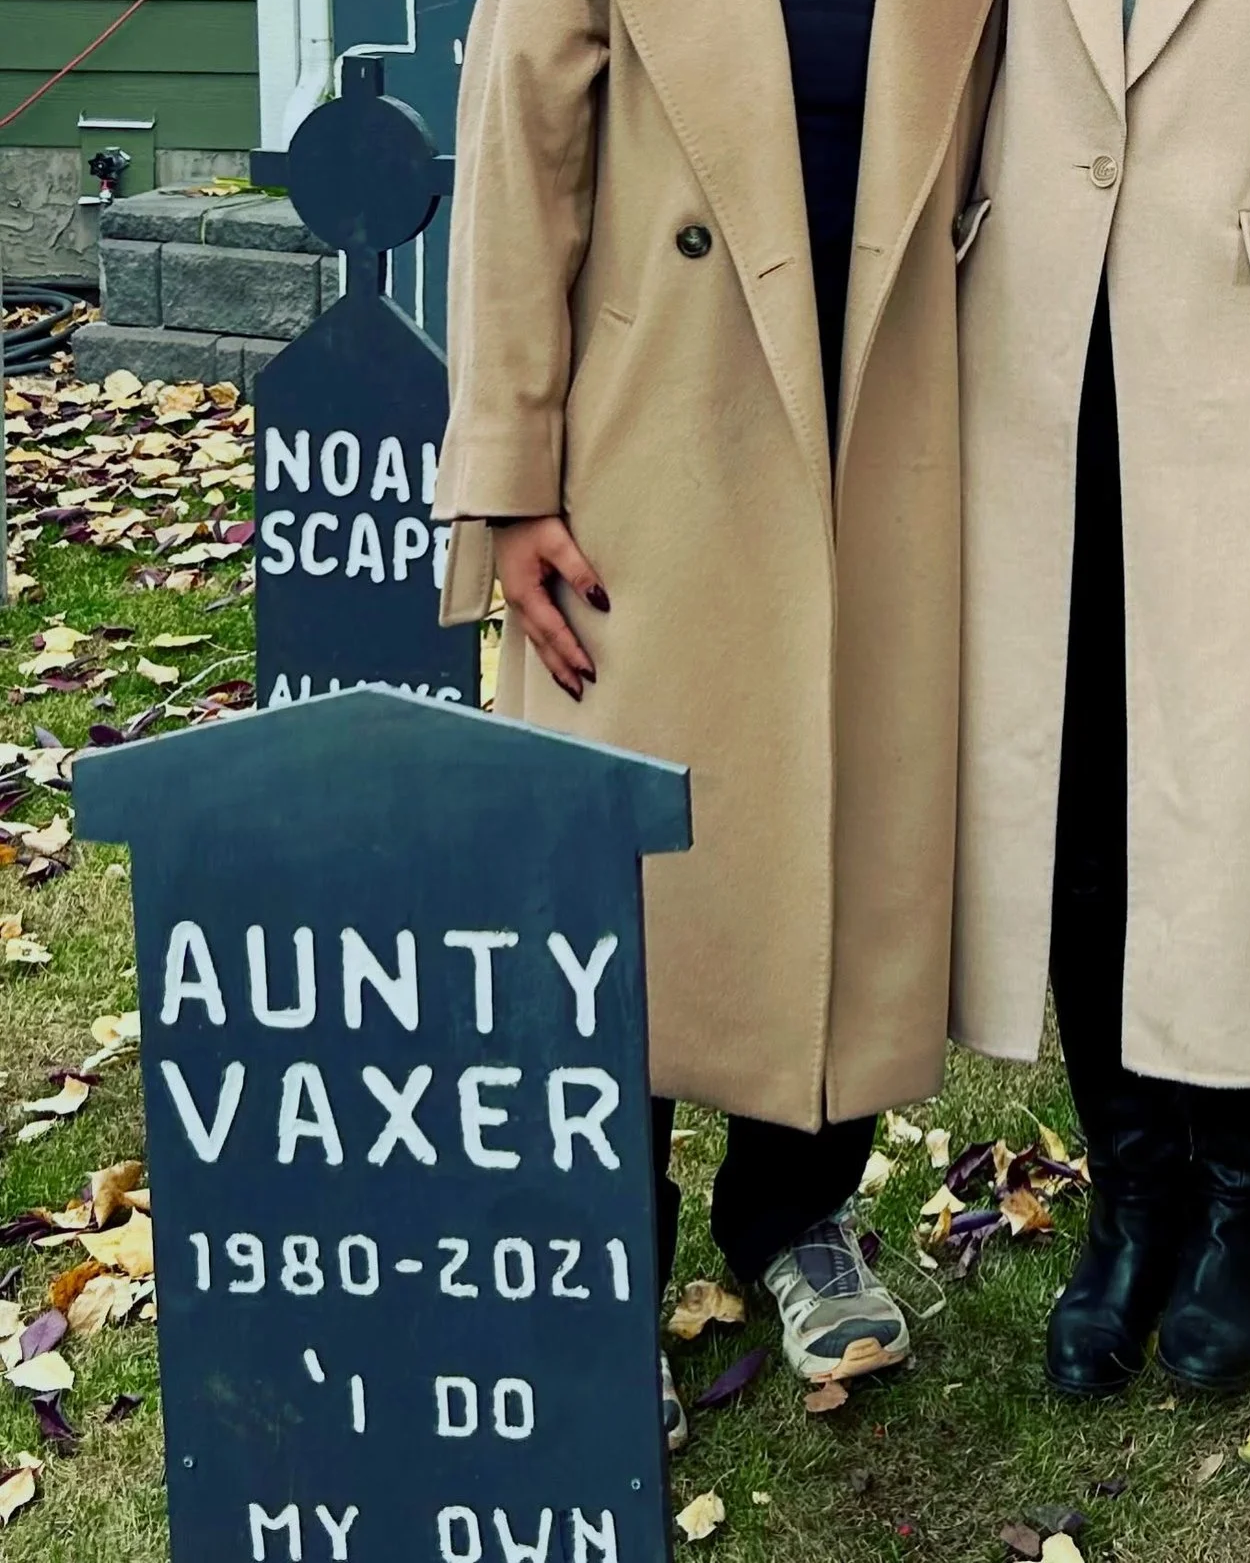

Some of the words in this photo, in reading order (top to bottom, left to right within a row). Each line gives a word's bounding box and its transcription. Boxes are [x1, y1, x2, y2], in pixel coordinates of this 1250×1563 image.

[160, 920, 618, 1038] AUNTY
[160, 1060, 621, 1170] VAXER
[188, 1232, 631, 1301] 1980-2021
[435, 1375, 534, 1438] DO
[248, 1503, 359, 1562] MY
[437, 1505, 618, 1563] OWN
